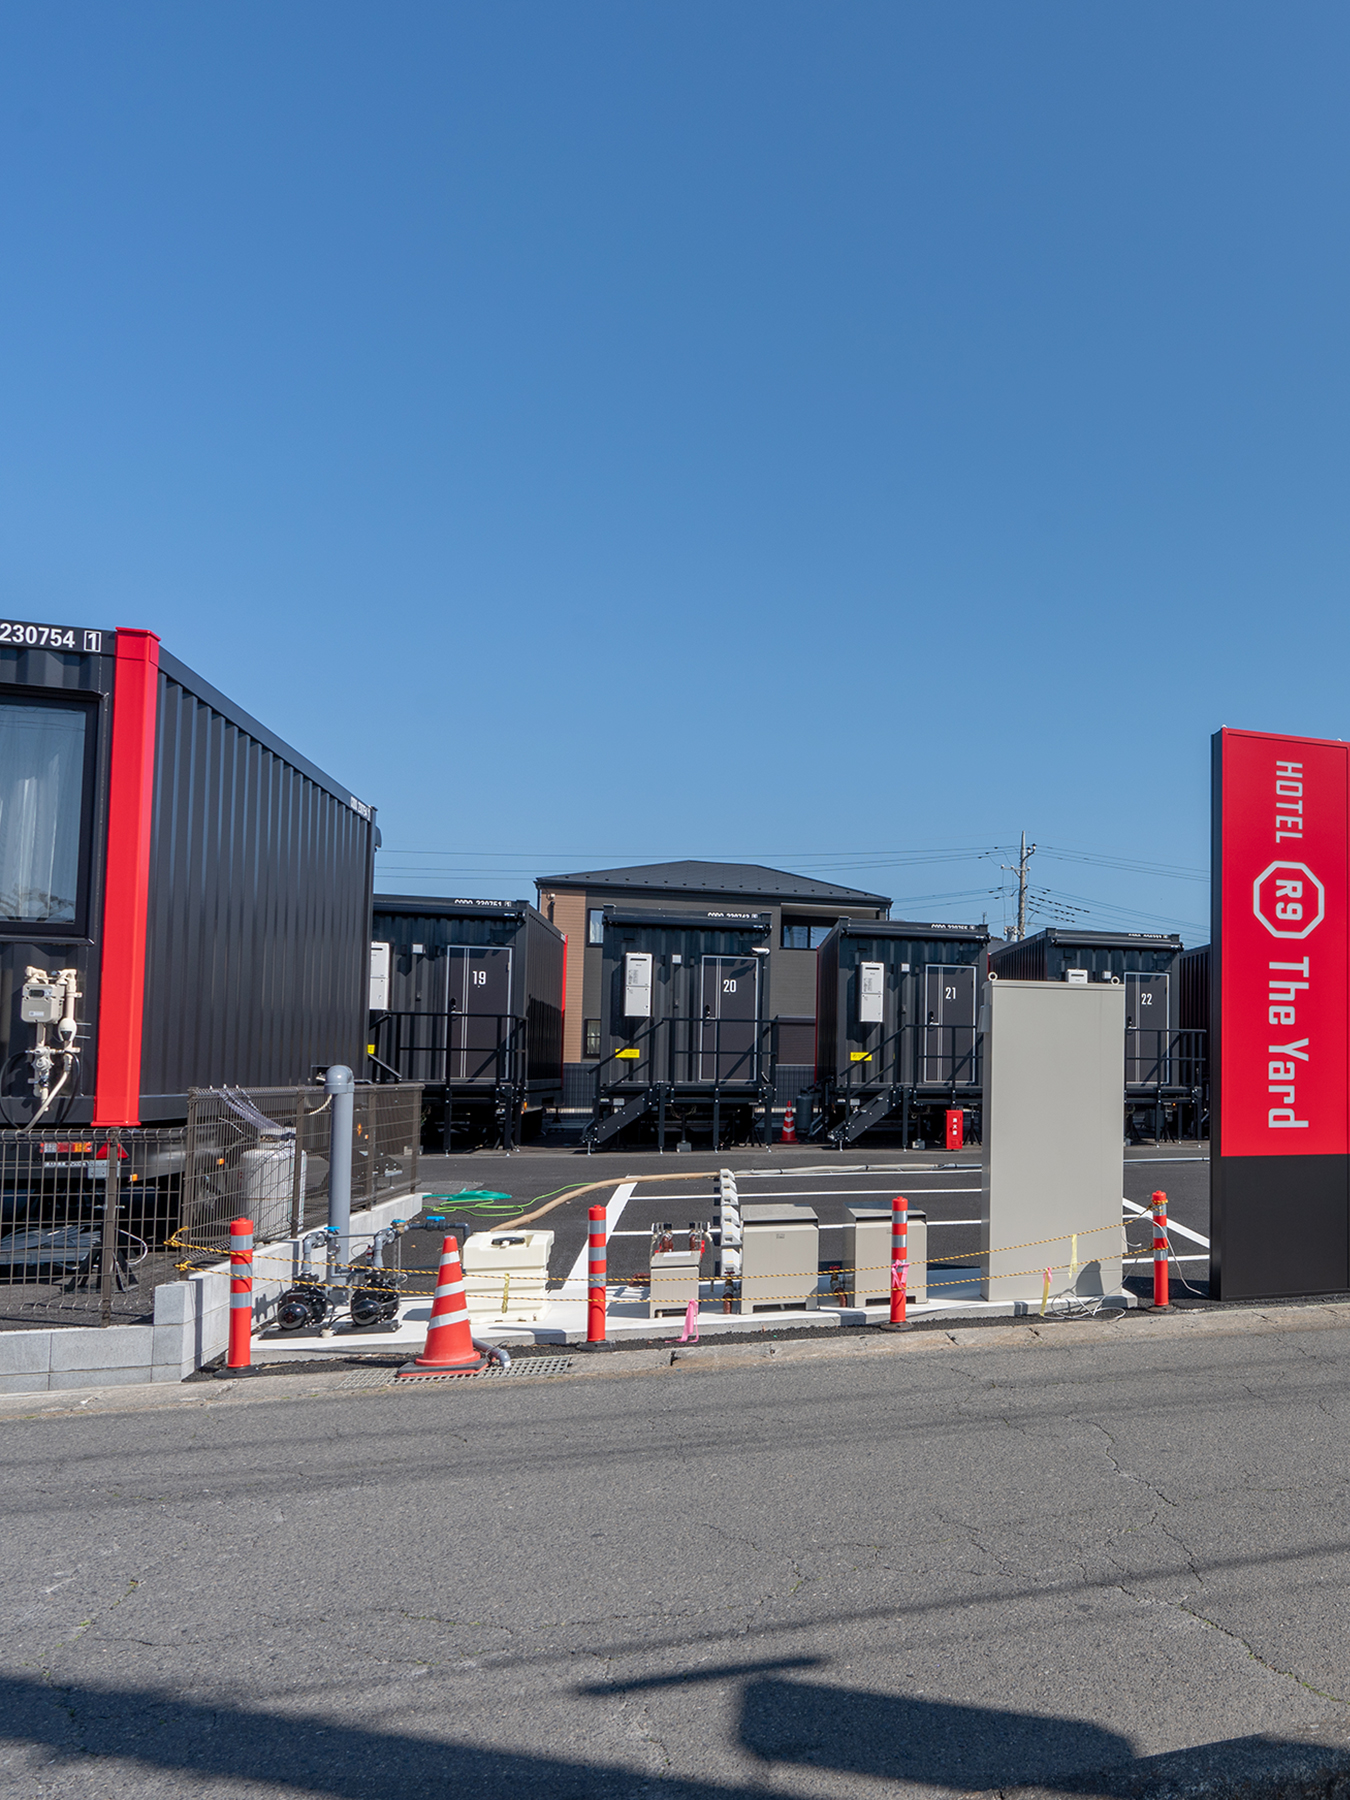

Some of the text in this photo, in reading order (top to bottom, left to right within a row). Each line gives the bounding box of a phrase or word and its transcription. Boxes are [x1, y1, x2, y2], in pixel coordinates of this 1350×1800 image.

[0, 623, 99, 652] 230754 1
[1276, 760, 1303, 843] HOTEL
[1276, 879, 1303, 921] R9
[472, 970, 486, 985] 19
[723, 979, 737, 993] 20
[945, 986, 956, 999] 21
[1141, 992, 1153, 1005] 22
[1268, 956, 1309, 1128] The Yard
